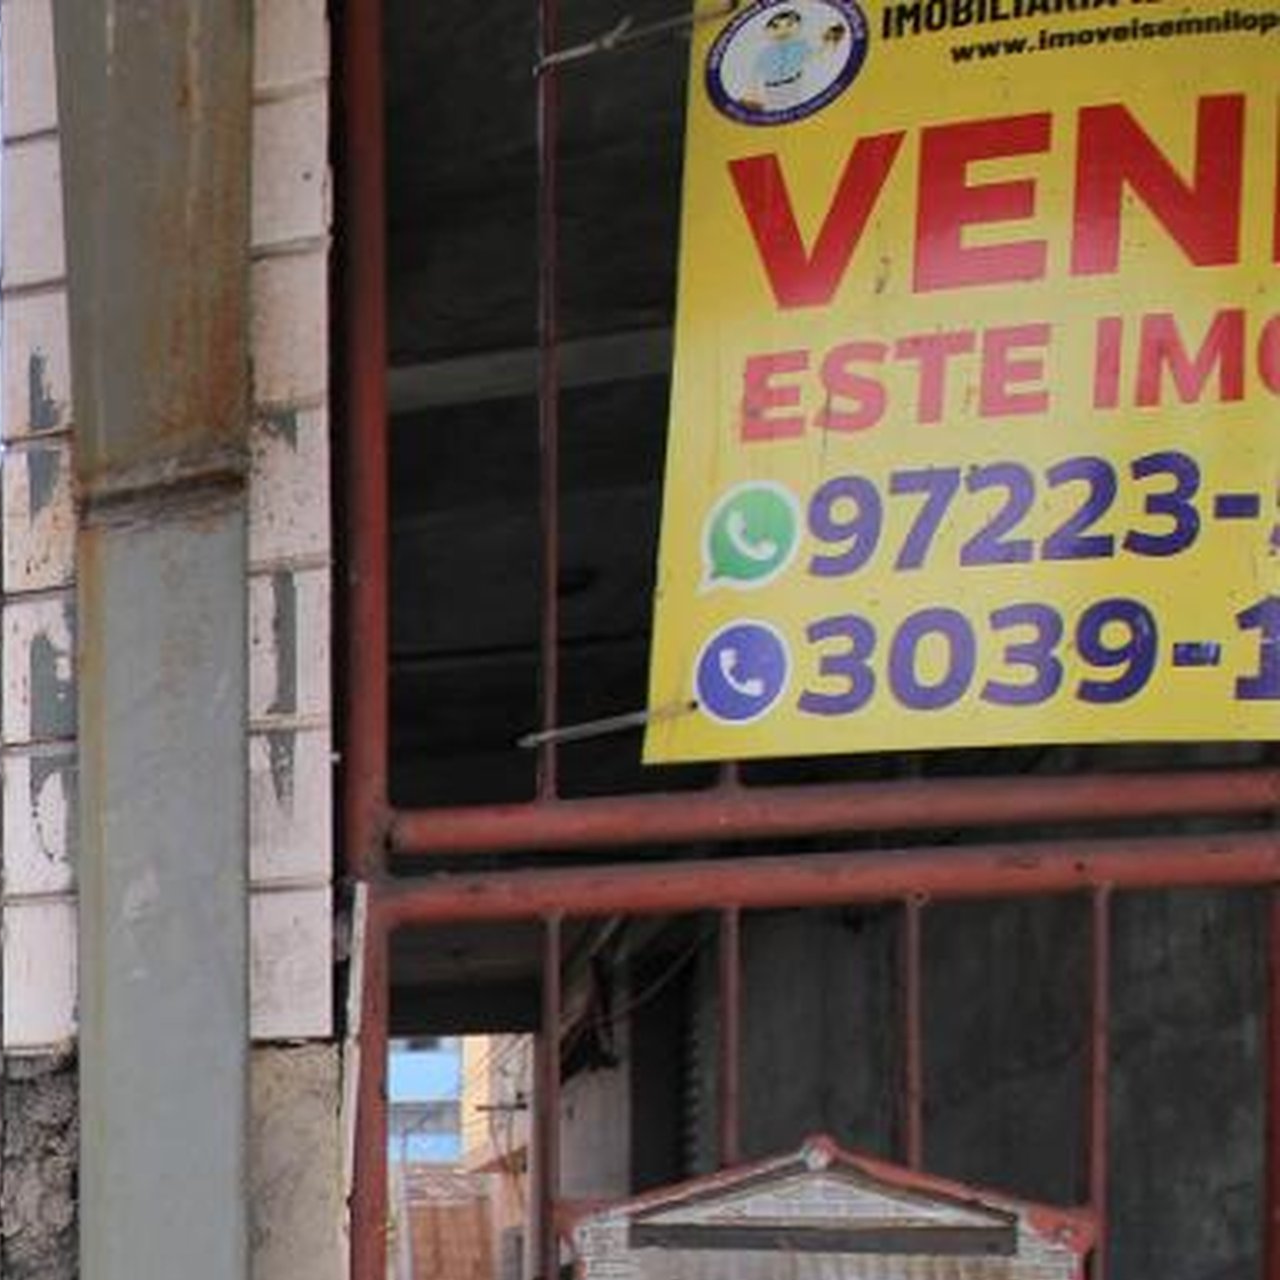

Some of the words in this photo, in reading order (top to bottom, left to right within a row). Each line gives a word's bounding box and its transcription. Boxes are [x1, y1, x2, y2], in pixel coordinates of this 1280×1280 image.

[727, 93, 1280, 309] VEN
[740, 323, 1050, 444] ESTE
[1092, 308, 1280, 410] IM
[806, 451, 1280, 578] 97223-
